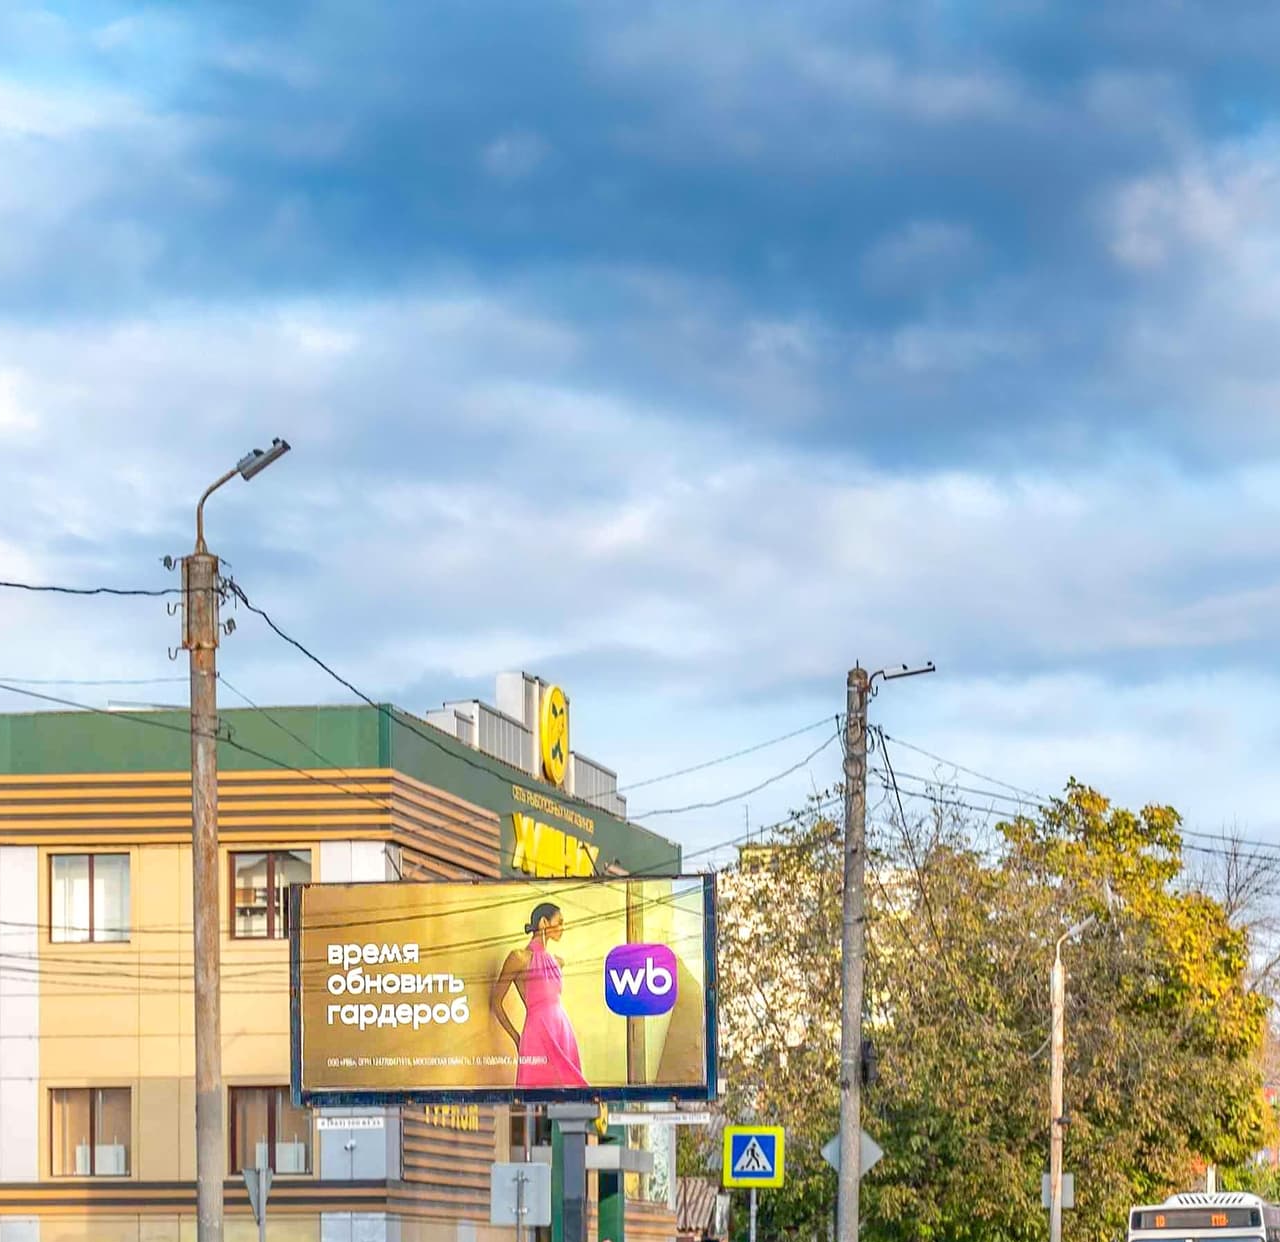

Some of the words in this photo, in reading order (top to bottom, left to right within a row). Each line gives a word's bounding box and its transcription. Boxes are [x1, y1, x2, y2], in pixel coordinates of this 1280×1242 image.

[327, 943, 419, 970] время
[327, 966, 465, 995] обновить
[609, 957, 673, 996] wb
[327, 995, 470, 1030] гардероб
